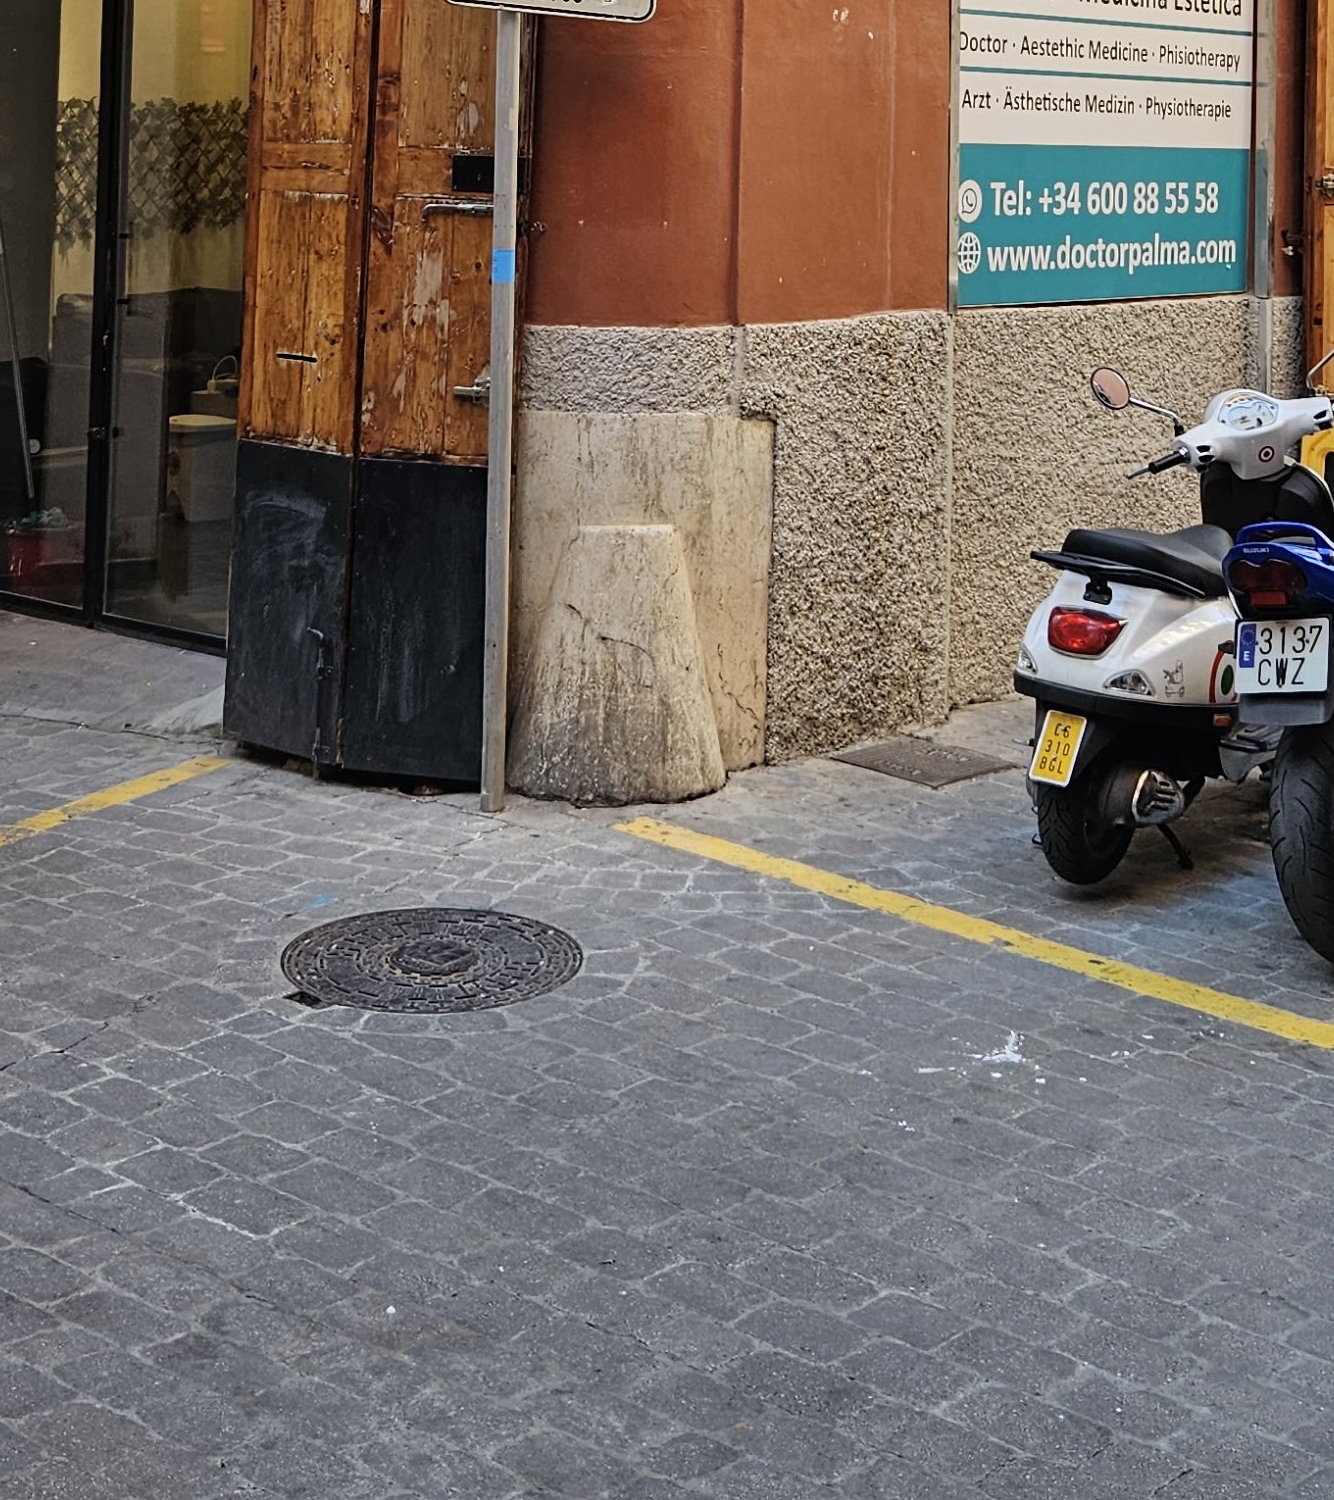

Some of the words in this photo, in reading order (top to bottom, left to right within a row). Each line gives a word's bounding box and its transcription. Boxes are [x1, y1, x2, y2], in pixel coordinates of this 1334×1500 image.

[959, 31, 1008, 54] Doctor
[1020, 35, 1085, 59] Aestethic
[1088, 40, 1148, 63] Medicine
[1159, 45, 1240, 73] Phisiotherapy
[962, 89, 992, 110] Arzt
[1003, 86, 1081, 113] Ästhetische
[1085, 94, 1135, 115] Medizin
[1146, 96, 1232, 122] Physiotherapie
[990, 180, 1032, 216] Tel:
[1038, 181, 1082, 216] +34
[1087, 181, 1128, 215] 600
[1133, 181, 1159, 214] 88
[1164, 181, 1189, 214] 55
[1194, 181, 1219, 214] 58
[987, 232, 1237, 275] www.doctorpalma.com
[1259, 625, 1323, 655] 3137
[1243, 651, 1250, 661] E
[1257, 657, 1305, 686] CWZ
[1045, 739, 1070, 756] 310
[1039, 756, 1063, 775] BGL
